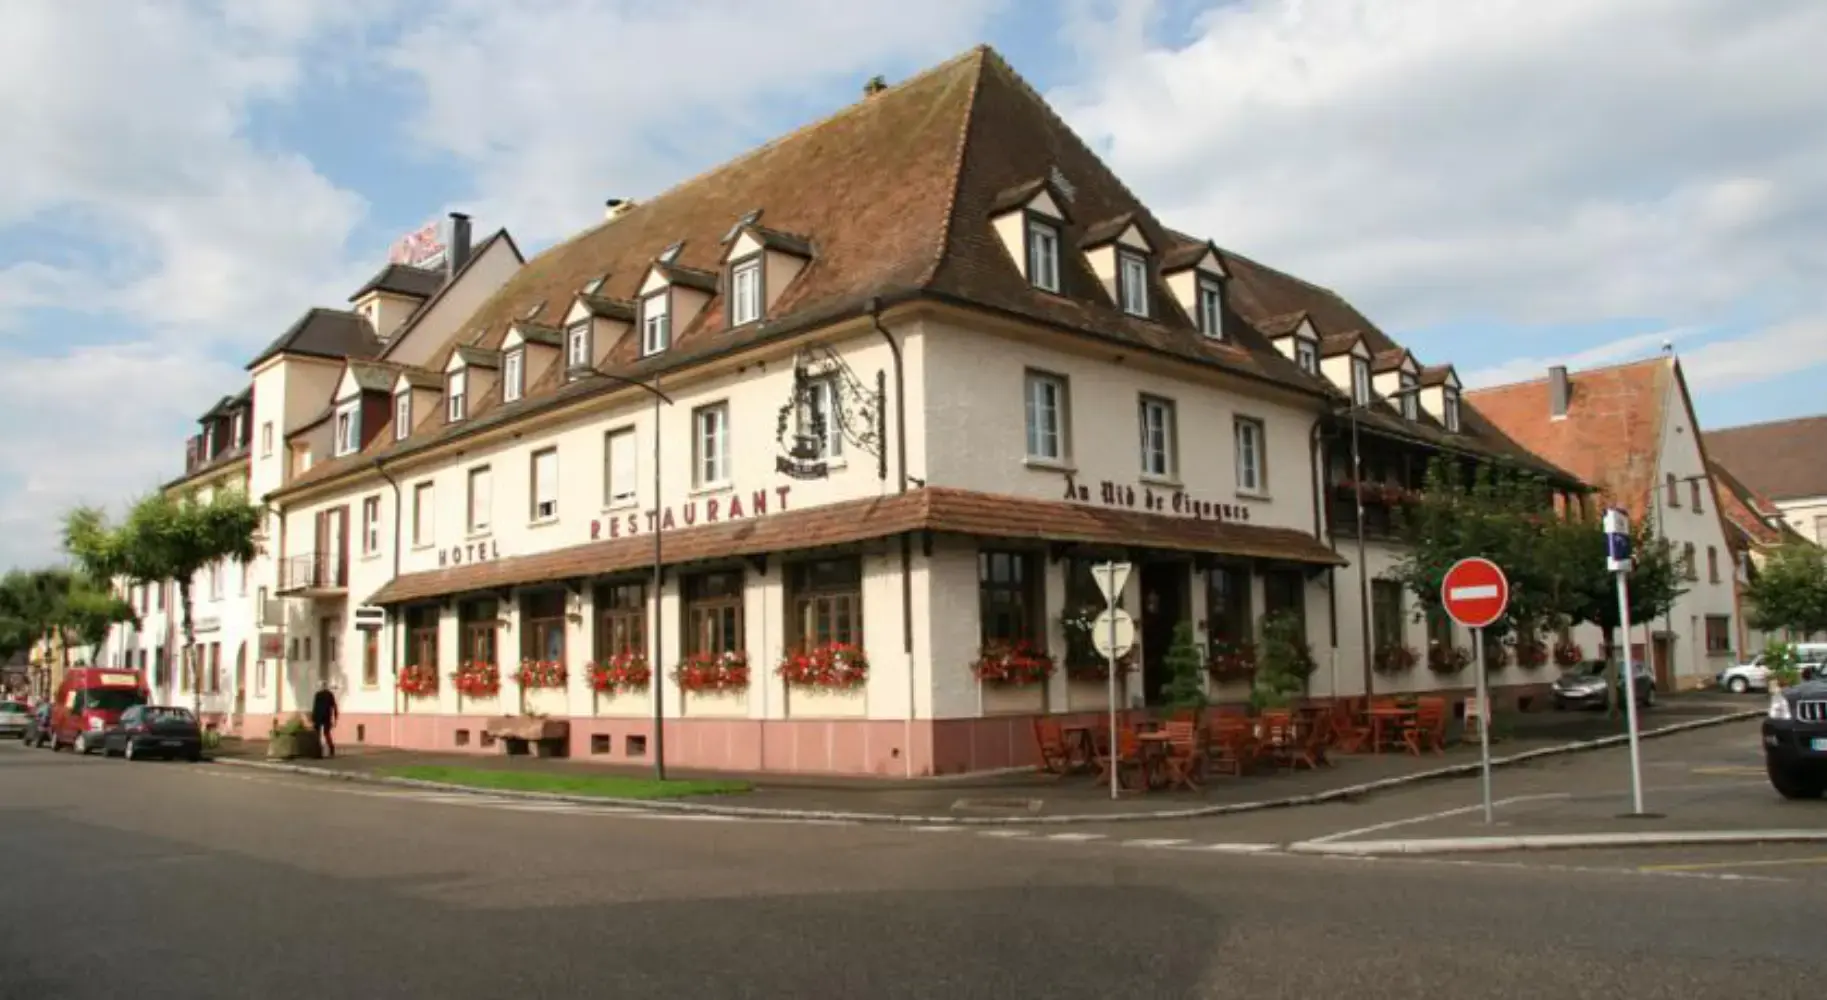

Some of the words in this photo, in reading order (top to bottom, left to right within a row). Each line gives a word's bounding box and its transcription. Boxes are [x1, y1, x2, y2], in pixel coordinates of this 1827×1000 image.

[591, 486, 790, 539] RESTAURANT
[1064, 474, 1089, 500] Au
[1101, 481, 1135, 507] Nid
[1145, 487, 1164, 511] de
